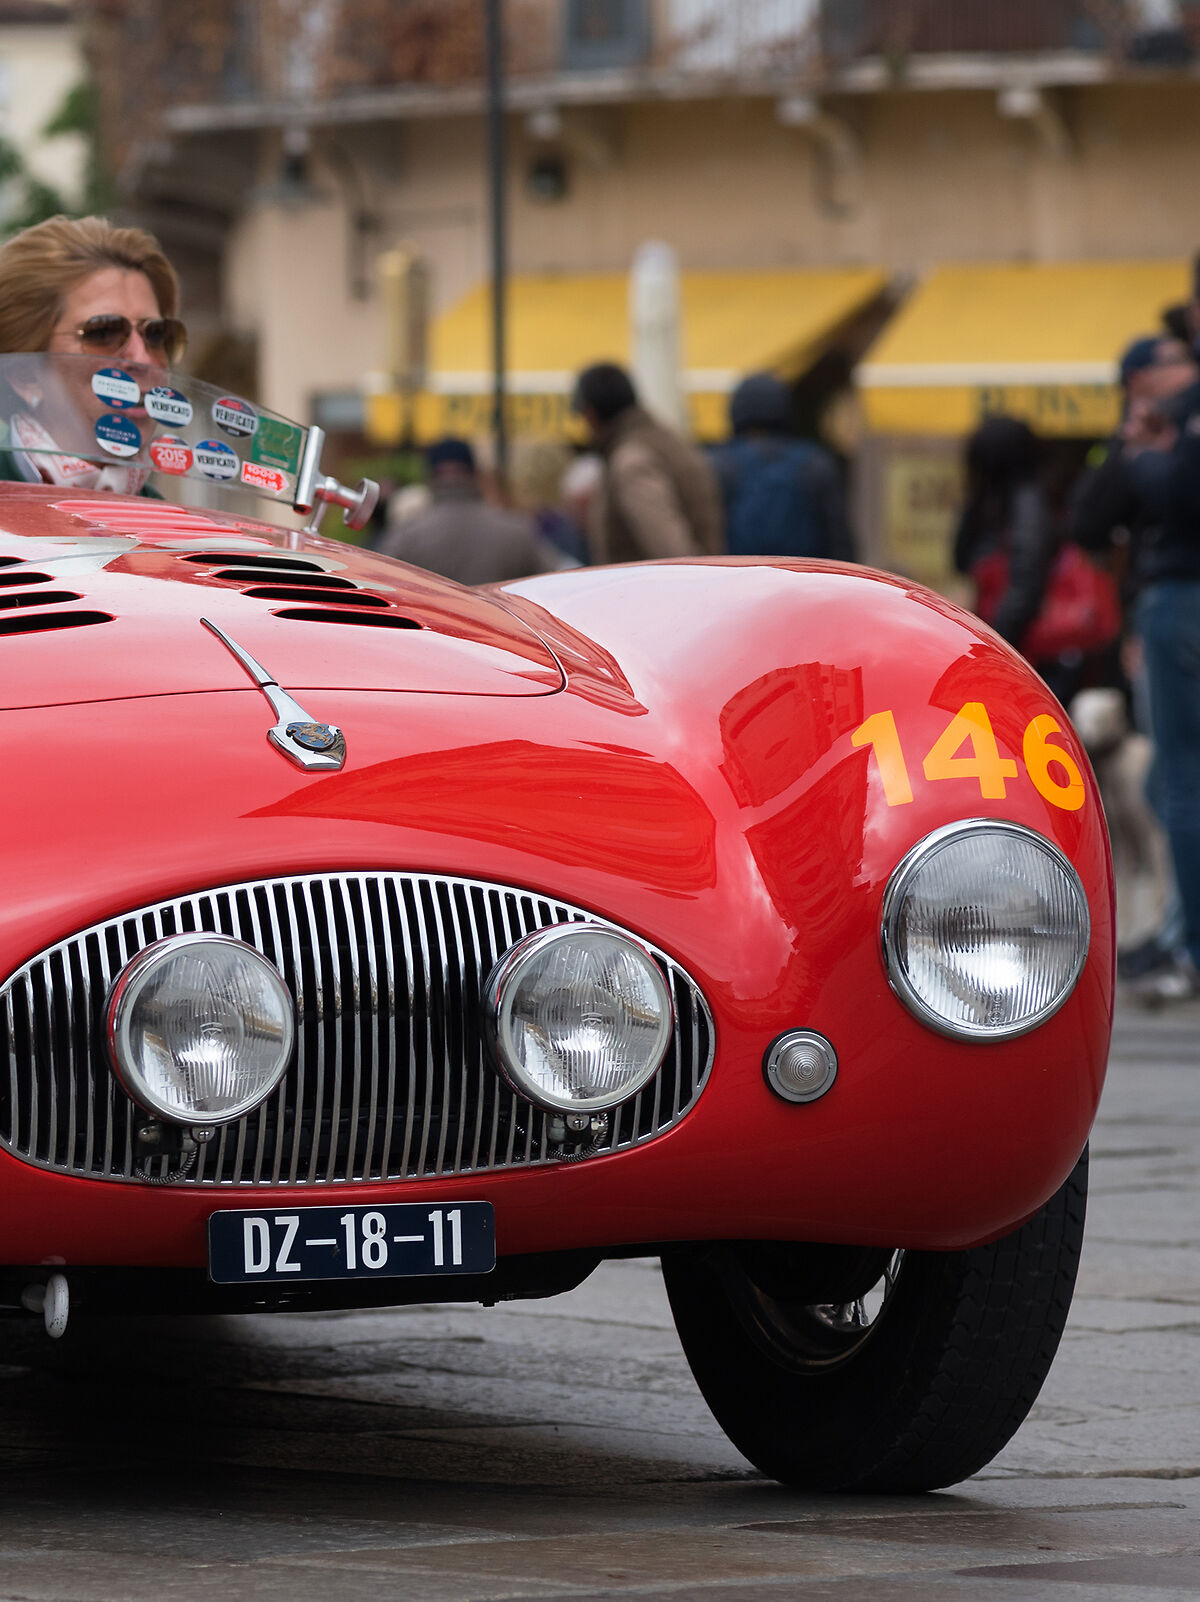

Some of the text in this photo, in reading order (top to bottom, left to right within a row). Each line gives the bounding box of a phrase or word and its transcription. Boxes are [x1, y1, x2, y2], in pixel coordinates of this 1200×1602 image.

[151, 400, 190, 417] VERIFICATO
[215, 408, 255, 430] VERIFICATO
[157, 447, 188, 463] 2015
[197, 455, 236, 469] VERIFICATO
[851, 702, 1086, 811] 146
[243, 1209, 463, 1274] DZ-18-11
